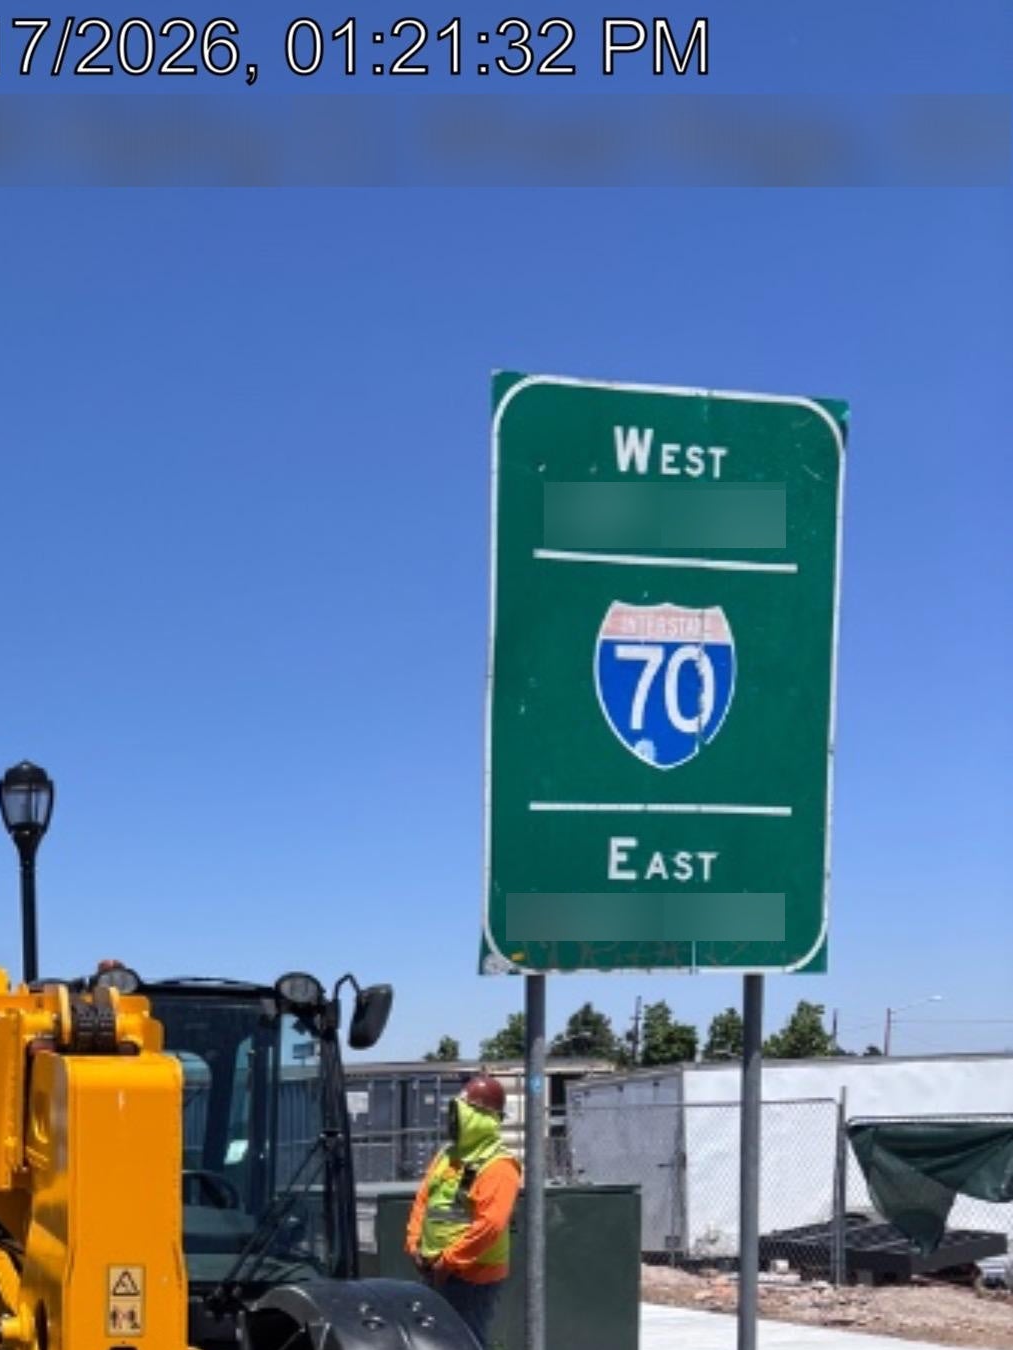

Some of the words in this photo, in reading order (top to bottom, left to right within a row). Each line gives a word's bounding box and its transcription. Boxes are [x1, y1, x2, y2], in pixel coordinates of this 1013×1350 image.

[613, 425, 728, 479] WEST
[614, 644, 715, 733] 70
[608, 837, 719, 882] EAST
